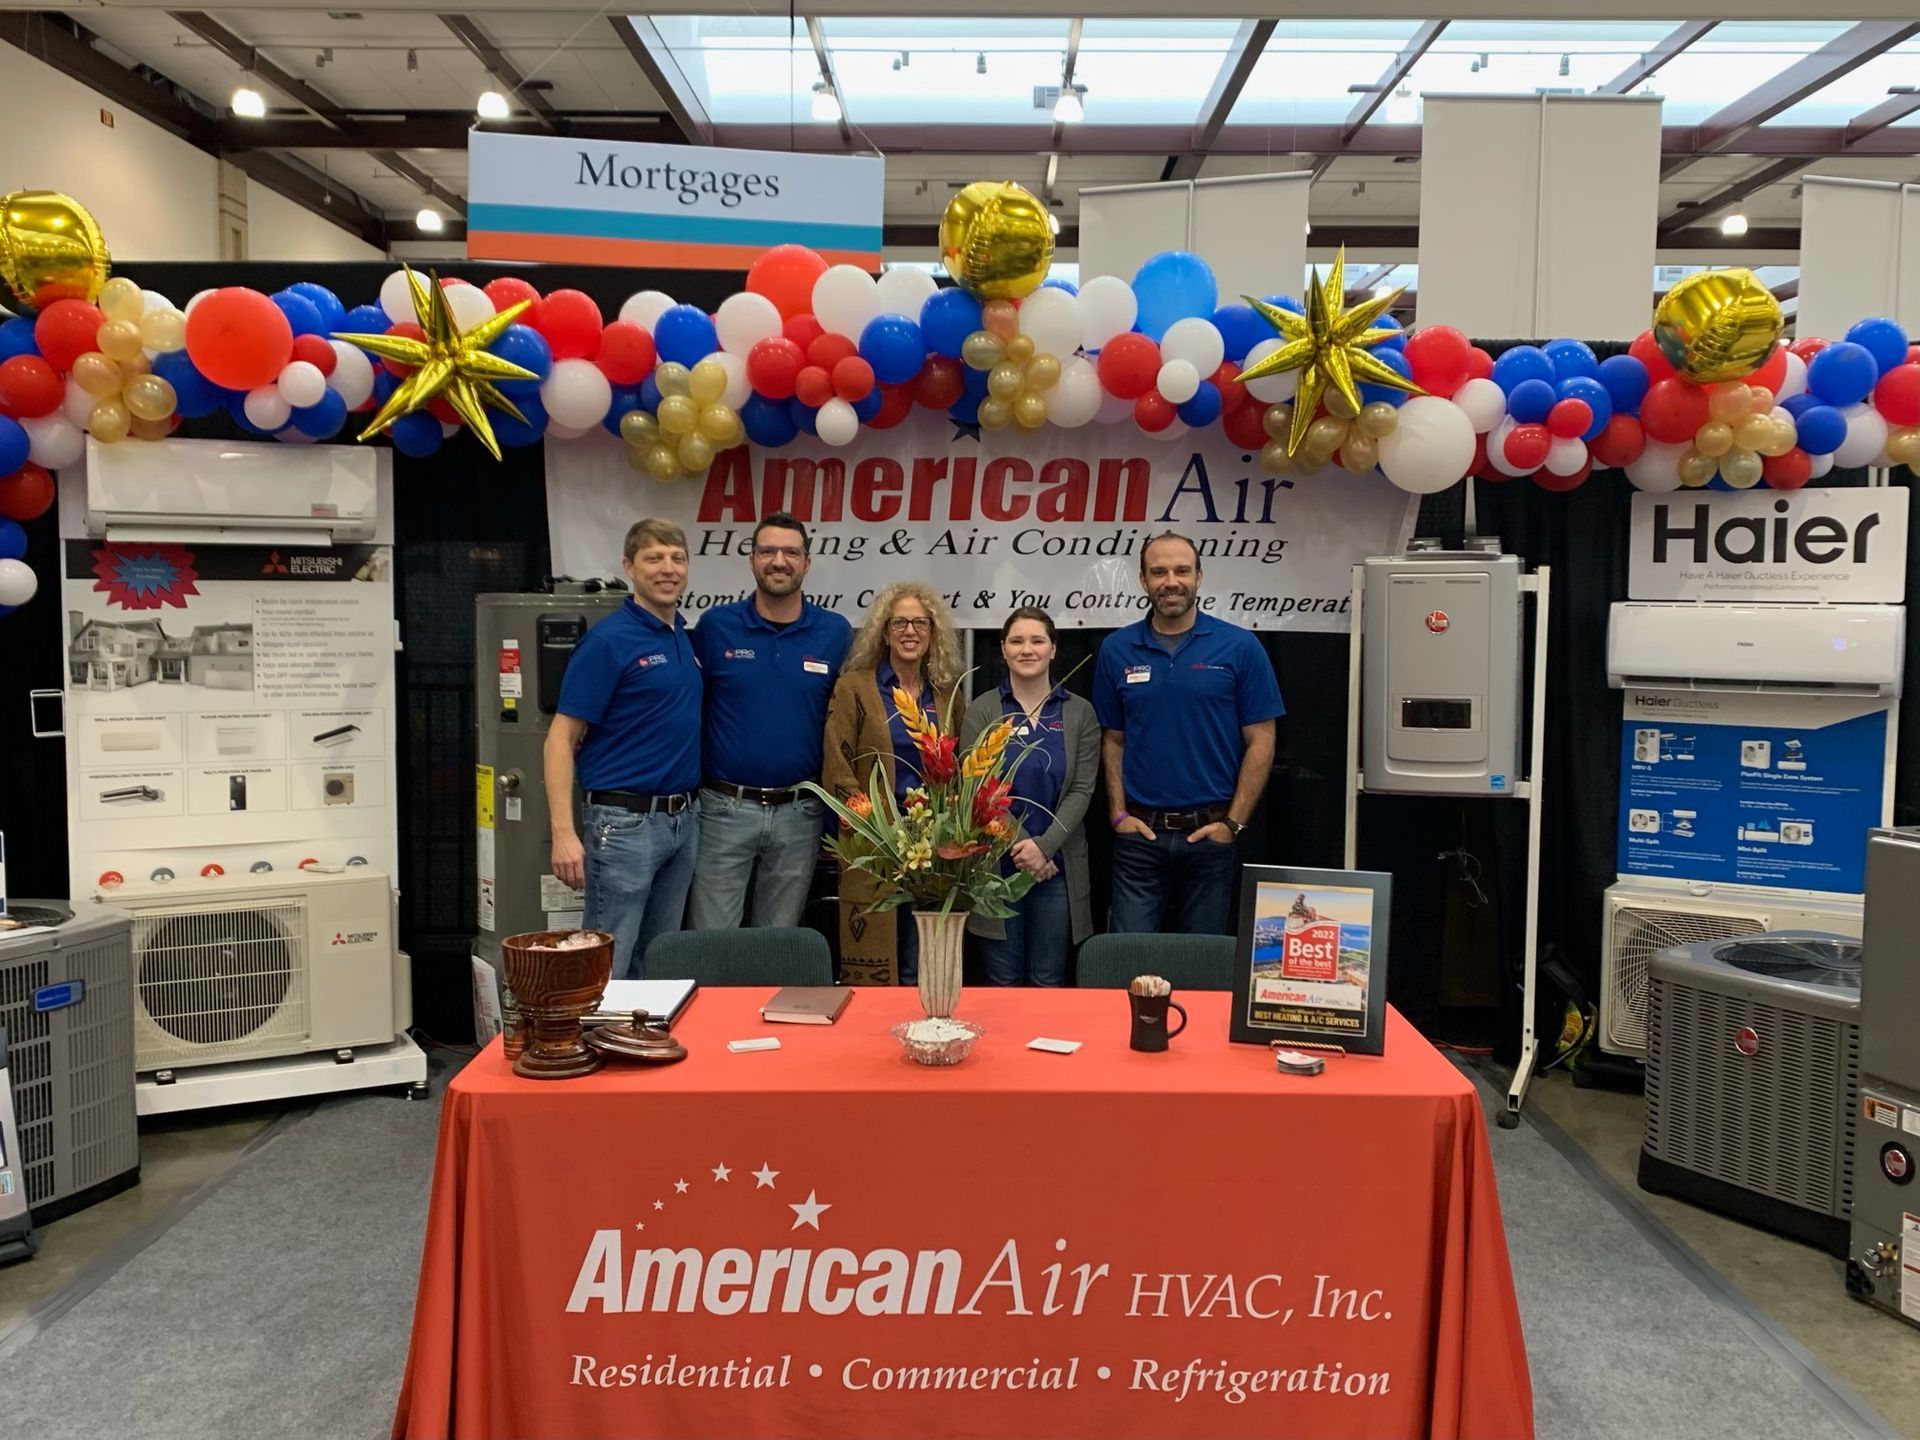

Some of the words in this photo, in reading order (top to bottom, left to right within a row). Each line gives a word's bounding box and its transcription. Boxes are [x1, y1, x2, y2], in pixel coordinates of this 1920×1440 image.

[574, 151, 780, 207] Mortgages
[696, 444, 1151, 523] American
[1154, 452, 1294, 524] Air
[1653, 499, 1880, 564] Haier
[694, 528, 869, 561] Heing
[879, 528, 915, 556] &
[925, 527, 998, 555] Air
[290, 556, 342, 566] MITSUBISHI
[290, 564, 336, 574] ELECTRIC
[1679, 571, 1704, 580] Have
[1706, 571, 1715, 580] A
[1716, 571, 1743, 581] Haier
[1744, 571, 1789, 581] Ductless
[1791, 571, 1850, 583] Experience
[973, 589, 996, 609] &
[1008, 589, 1051, 609] You
[1065, 589, 1152, 610] Contro
[1635, 695, 1671, 707] Haier
[1312, 929, 1335, 940] 2022
[1289, 937, 1334, 960] Best
[1288, 957, 1298, 965] of
[1299, 958, 1313, 966] the
[1314, 959, 1332, 968] best
[1261, 988, 1307, 1003] American
[1254, 1010, 1272, 1020] BEST
[1272, 1012, 1303, 1023] HEATING
[1303, 1015, 1310, 1024] &
[1310, 1016, 1325, 1025] A/C
[1325, 1017, 1360, 1027] SERVICES
[565, 1229, 963, 1317] American
[958, 1237, 1109, 1317] Air
[1125, 1273, 1295, 1326] HVAC,
[1308, 1275, 1393, 1321] Inc.
[569, 1354, 792, 1390] Residential
[842, 1357, 1079, 1391] Commercial
[1129, 1358, 1391, 1404] Refrigeration
